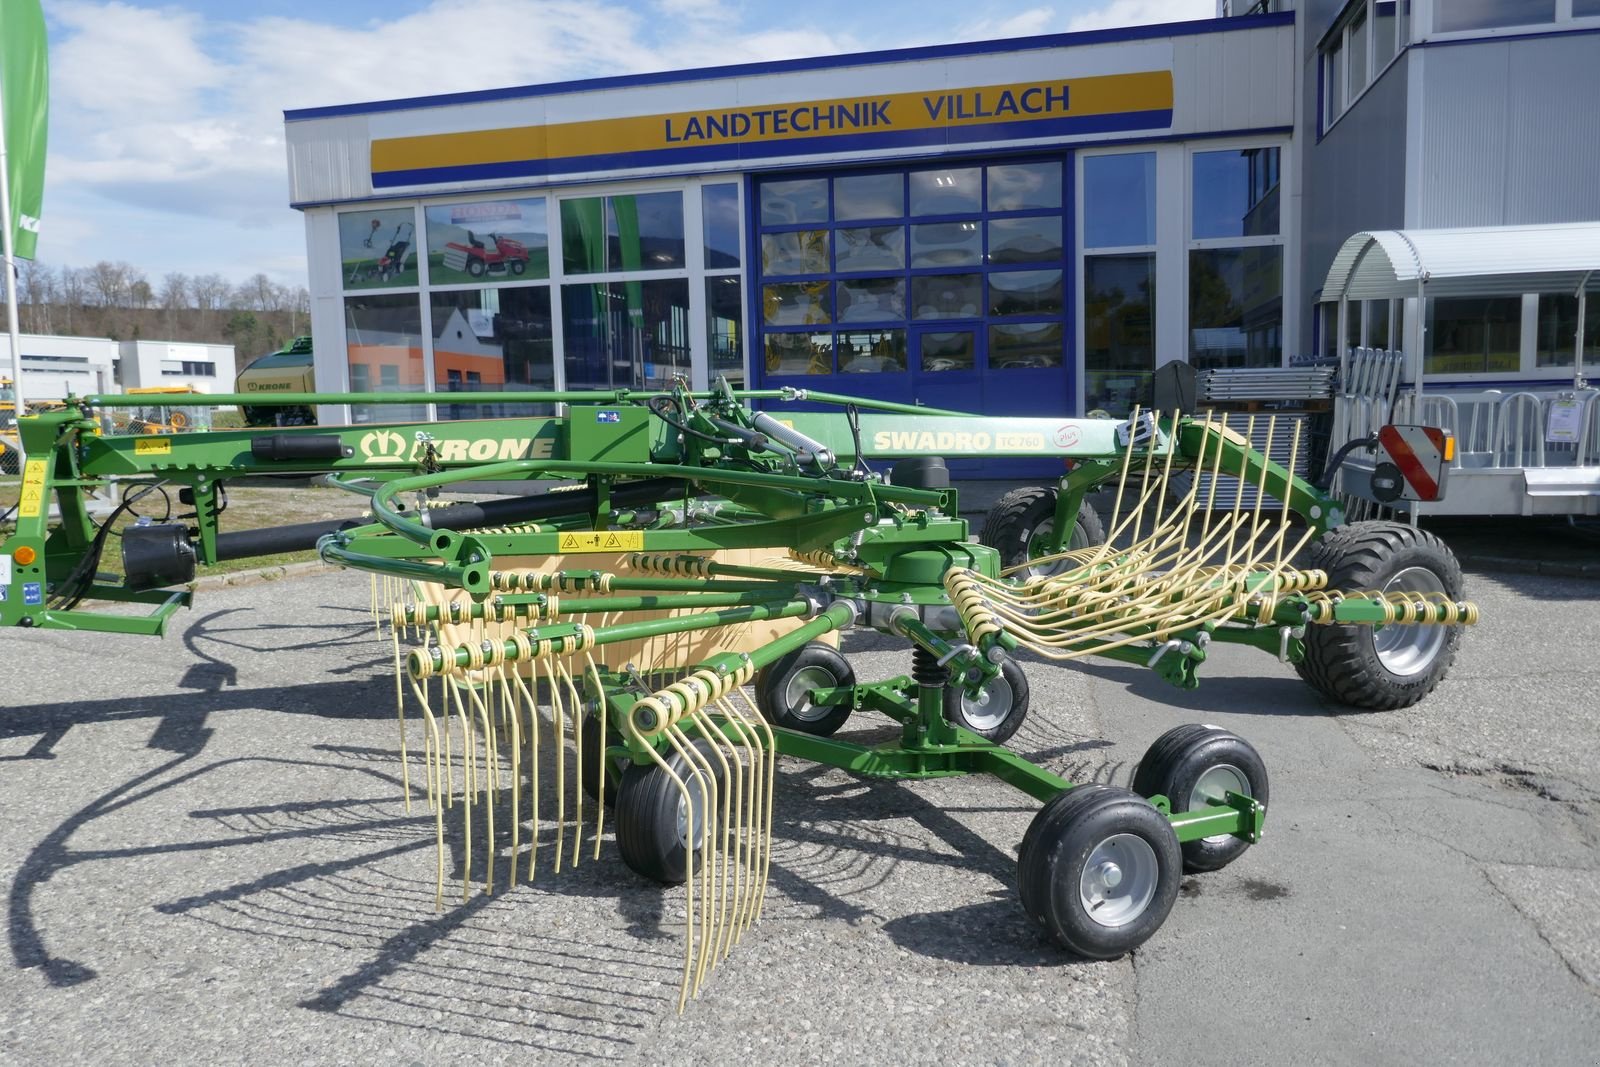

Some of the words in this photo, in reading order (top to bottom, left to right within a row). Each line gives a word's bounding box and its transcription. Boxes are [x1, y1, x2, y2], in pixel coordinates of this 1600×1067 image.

[665, 101, 891, 142] LANDTECHNIK
[923, 86, 1069, 120] VILLACH
[451, 203, 520, 218] HONDA
[258, 382, 292, 391] KRONE
[874, 431, 991, 450] SWADRO
[1001, 437, 1016, 447] TC
[1019, 436, 1040, 447] 760
